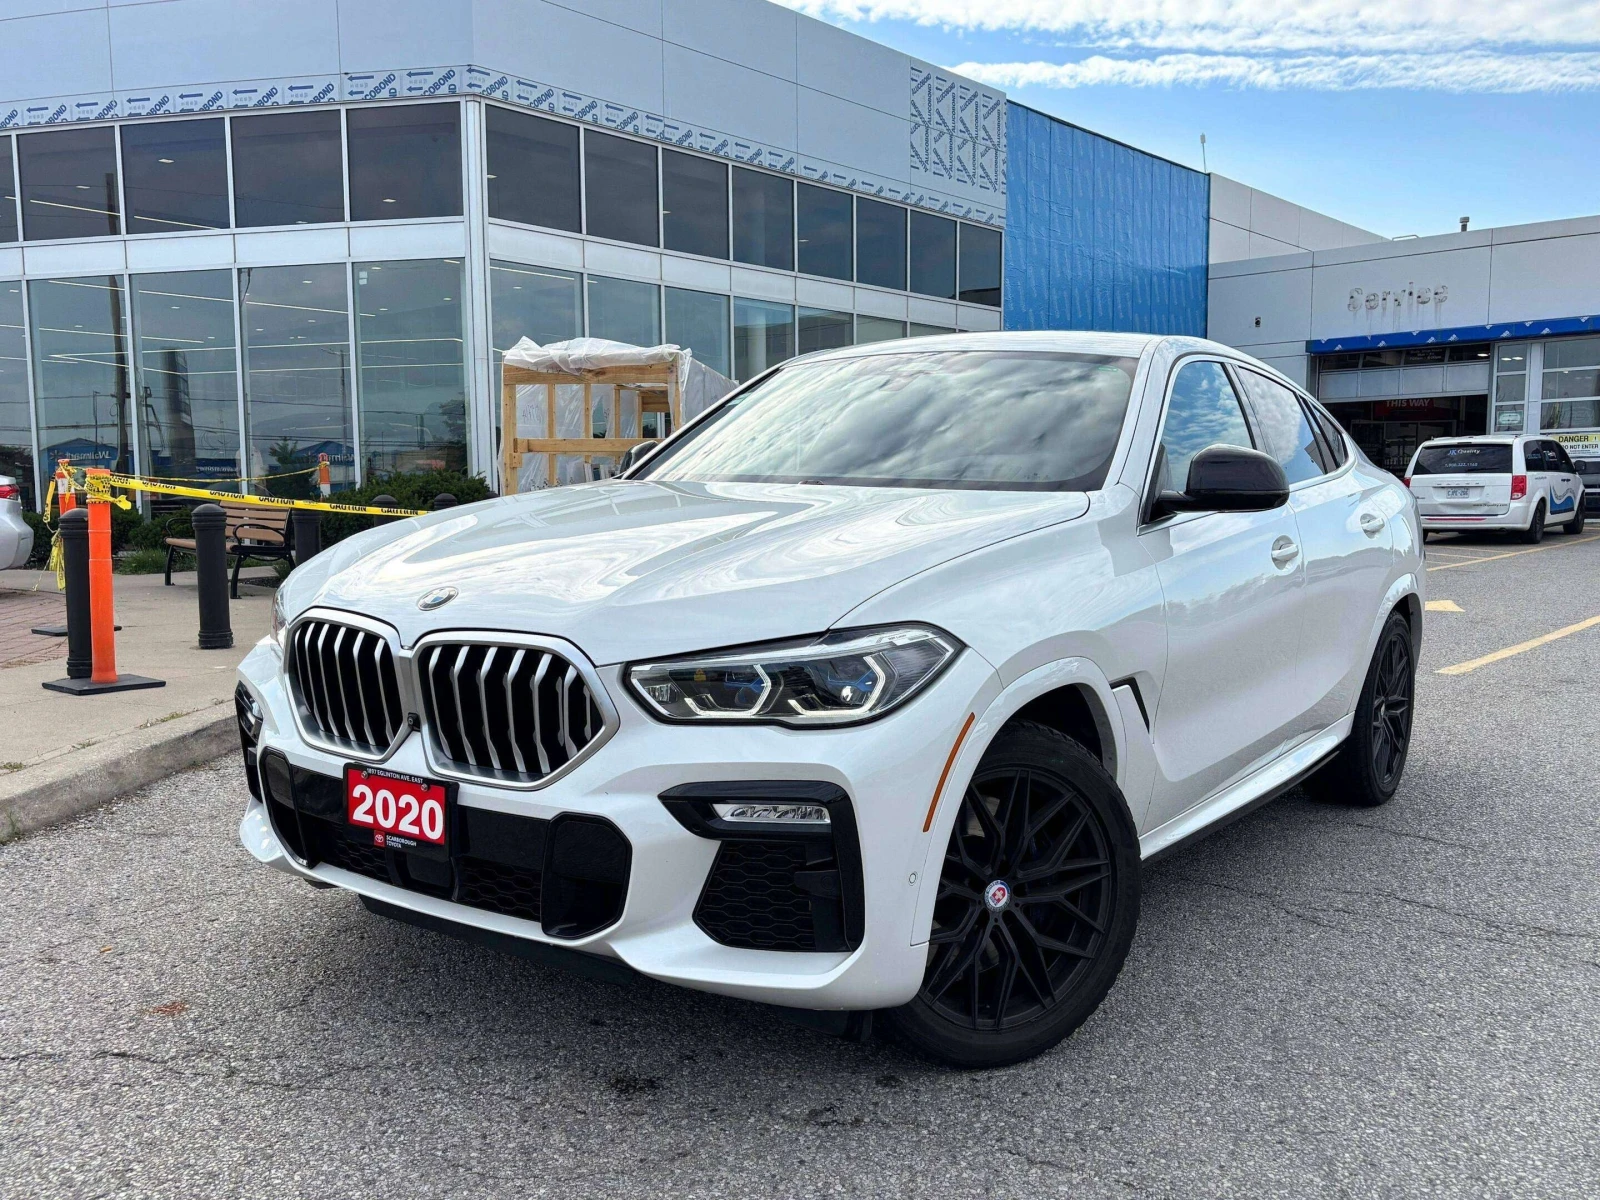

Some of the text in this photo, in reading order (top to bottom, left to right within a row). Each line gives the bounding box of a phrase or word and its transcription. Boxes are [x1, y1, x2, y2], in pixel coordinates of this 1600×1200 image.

[1409, 399, 1430, 407] WAY
[1558, 435, 1589, 443] DANGER
[258, 496, 295, 506] CAUTION
[329, 503, 367, 512] CAUTION
[377, 769, 400, 780] EGLINTON
[411, 776, 423, 784] EAST
[352, 784, 444, 840] 2020
[386, 834, 417, 847] SCARBOROUGH
[386, 840, 402, 849] TOYOTA
